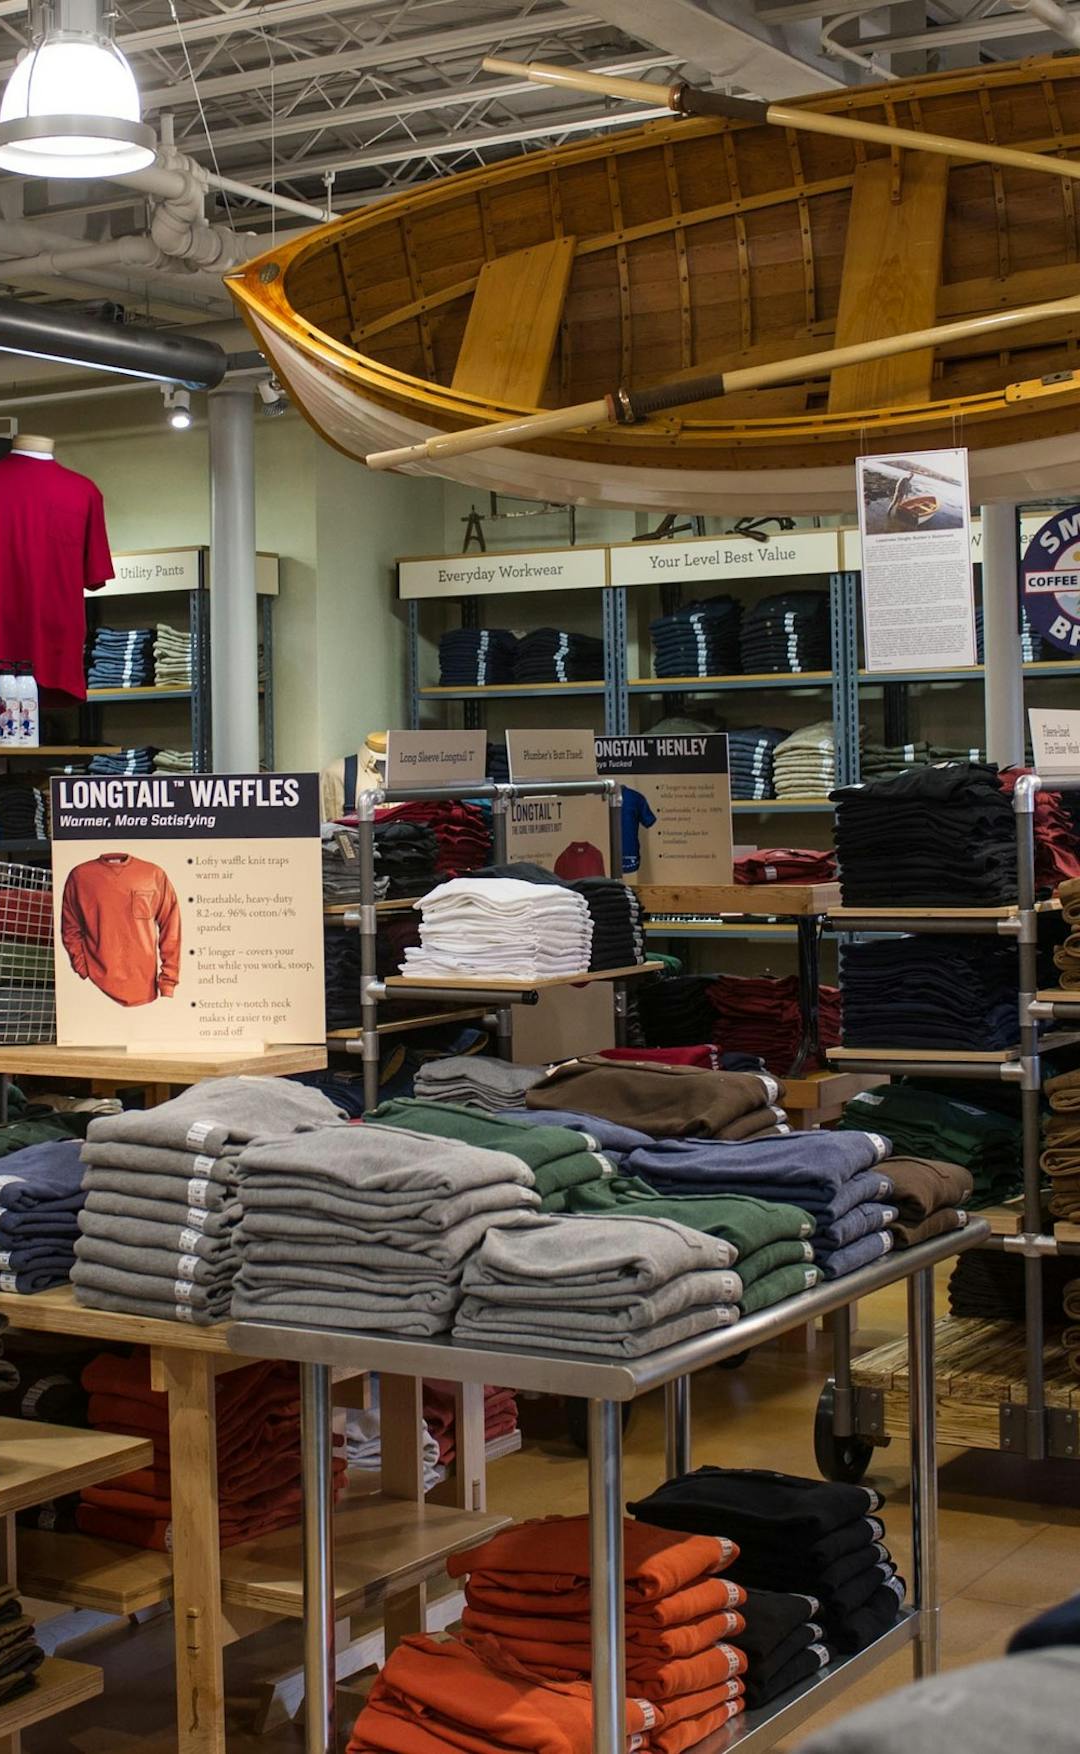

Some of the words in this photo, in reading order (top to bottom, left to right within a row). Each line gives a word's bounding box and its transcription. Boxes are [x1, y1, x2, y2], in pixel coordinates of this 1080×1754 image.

[649, 556, 680, 569] Your
[685, 551, 720, 567] Level
[724, 550, 754, 564] Best
[757, 546, 796, 561] Value
[120, 567, 152, 581] Utility
[155, 565, 184, 577] Pants
[438, 566, 495, 584] Everyday
[499, 563, 564, 579] Workwear
[1028, 575, 1078, 588] COFFEE
[657, 738, 707, 756] HENLEY
[400, 751, 417, 765] Long
[418, 750, 439, 763] Sleeve
[609, 760, 632, 768] Tucked
[190, 779, 300, 807] WAFFLES
[556, 802, 562, 819] T
[60, 814, 111, 828] Warmer,
[115, 814, 148, 826] More
[151, 813, 216, 829] Satisfying
[195, 856, 218, 867] Lofty
[221, 855, 246, 865] waffle
[248, 856, 266, 865] knit
[268, 857, 289, 868] traps
[222, 871, 233, 879] air
[196, 894, 244, 904] Breathable,
[246, 893, 293, 905] heavy-duty
[227, 908, 247, 918] 96%
[197, 923, 232, 935] spandex
[208, 946, 236, 958] longer
[246, 948, 273, 956] covers
[275, 948, 295, 958] your
[197, 961, 216, 970] butt
[218, 961, 241, 970] while
[243, 962, 259, 972] you
[288, 960, 314, 972] stoop,
[198, 974, 214, 984] and
[198, 998, 233, 1010] Stretchy
[236, 998, 269, 1008] v-notch
[271, 998, 291, 1008] neck
[199, 1013, 225, 1022] makes
[228, 1013, 234, 1022] it
[236, 1014, 260, 1022] easier
[262, 1014, 271, 1022] to
[273, 1014, 287, 1025] get
[212, 1026, 229, 1036] and
